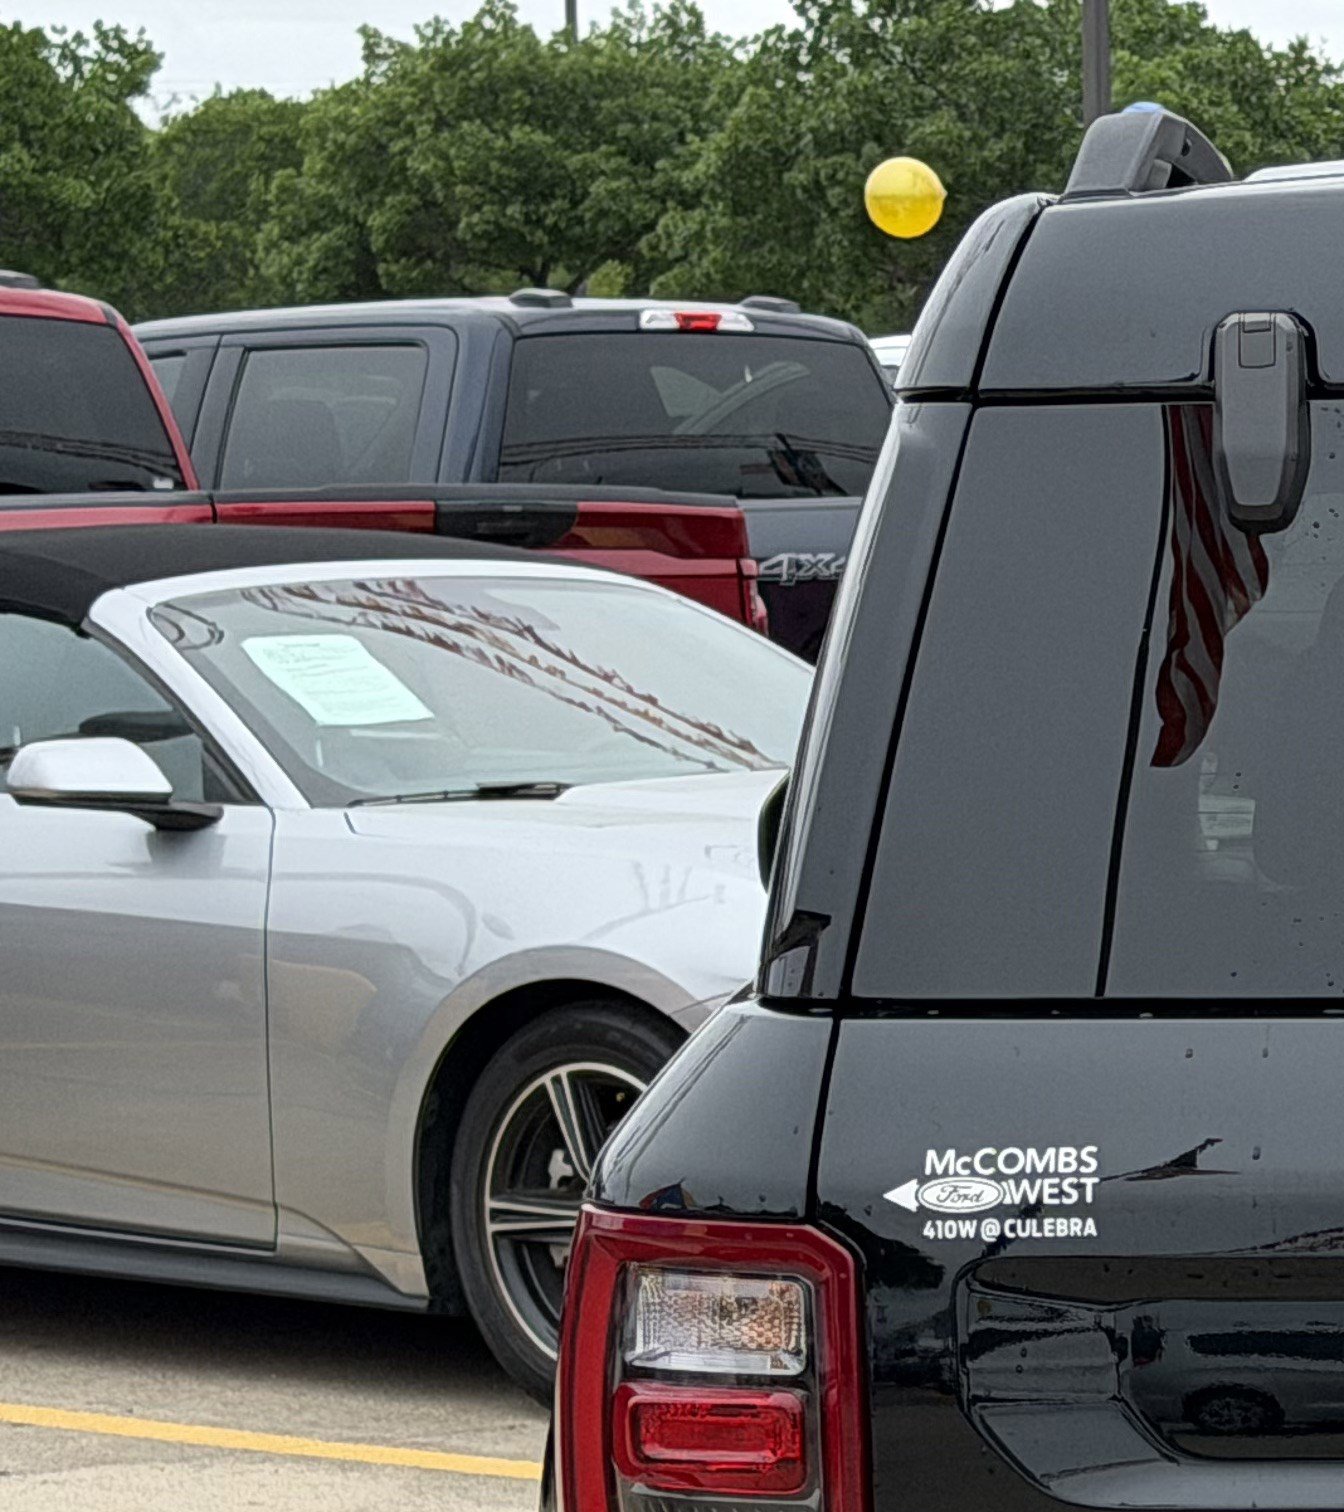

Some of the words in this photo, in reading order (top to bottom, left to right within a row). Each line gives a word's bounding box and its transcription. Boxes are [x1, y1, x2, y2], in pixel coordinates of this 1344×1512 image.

[924, 1145, 1098, 1175] McCOMBS
[1010, 1177, 1099, 1205] WEST
[1004, 1217, 1097, 1238] CULEBRA
